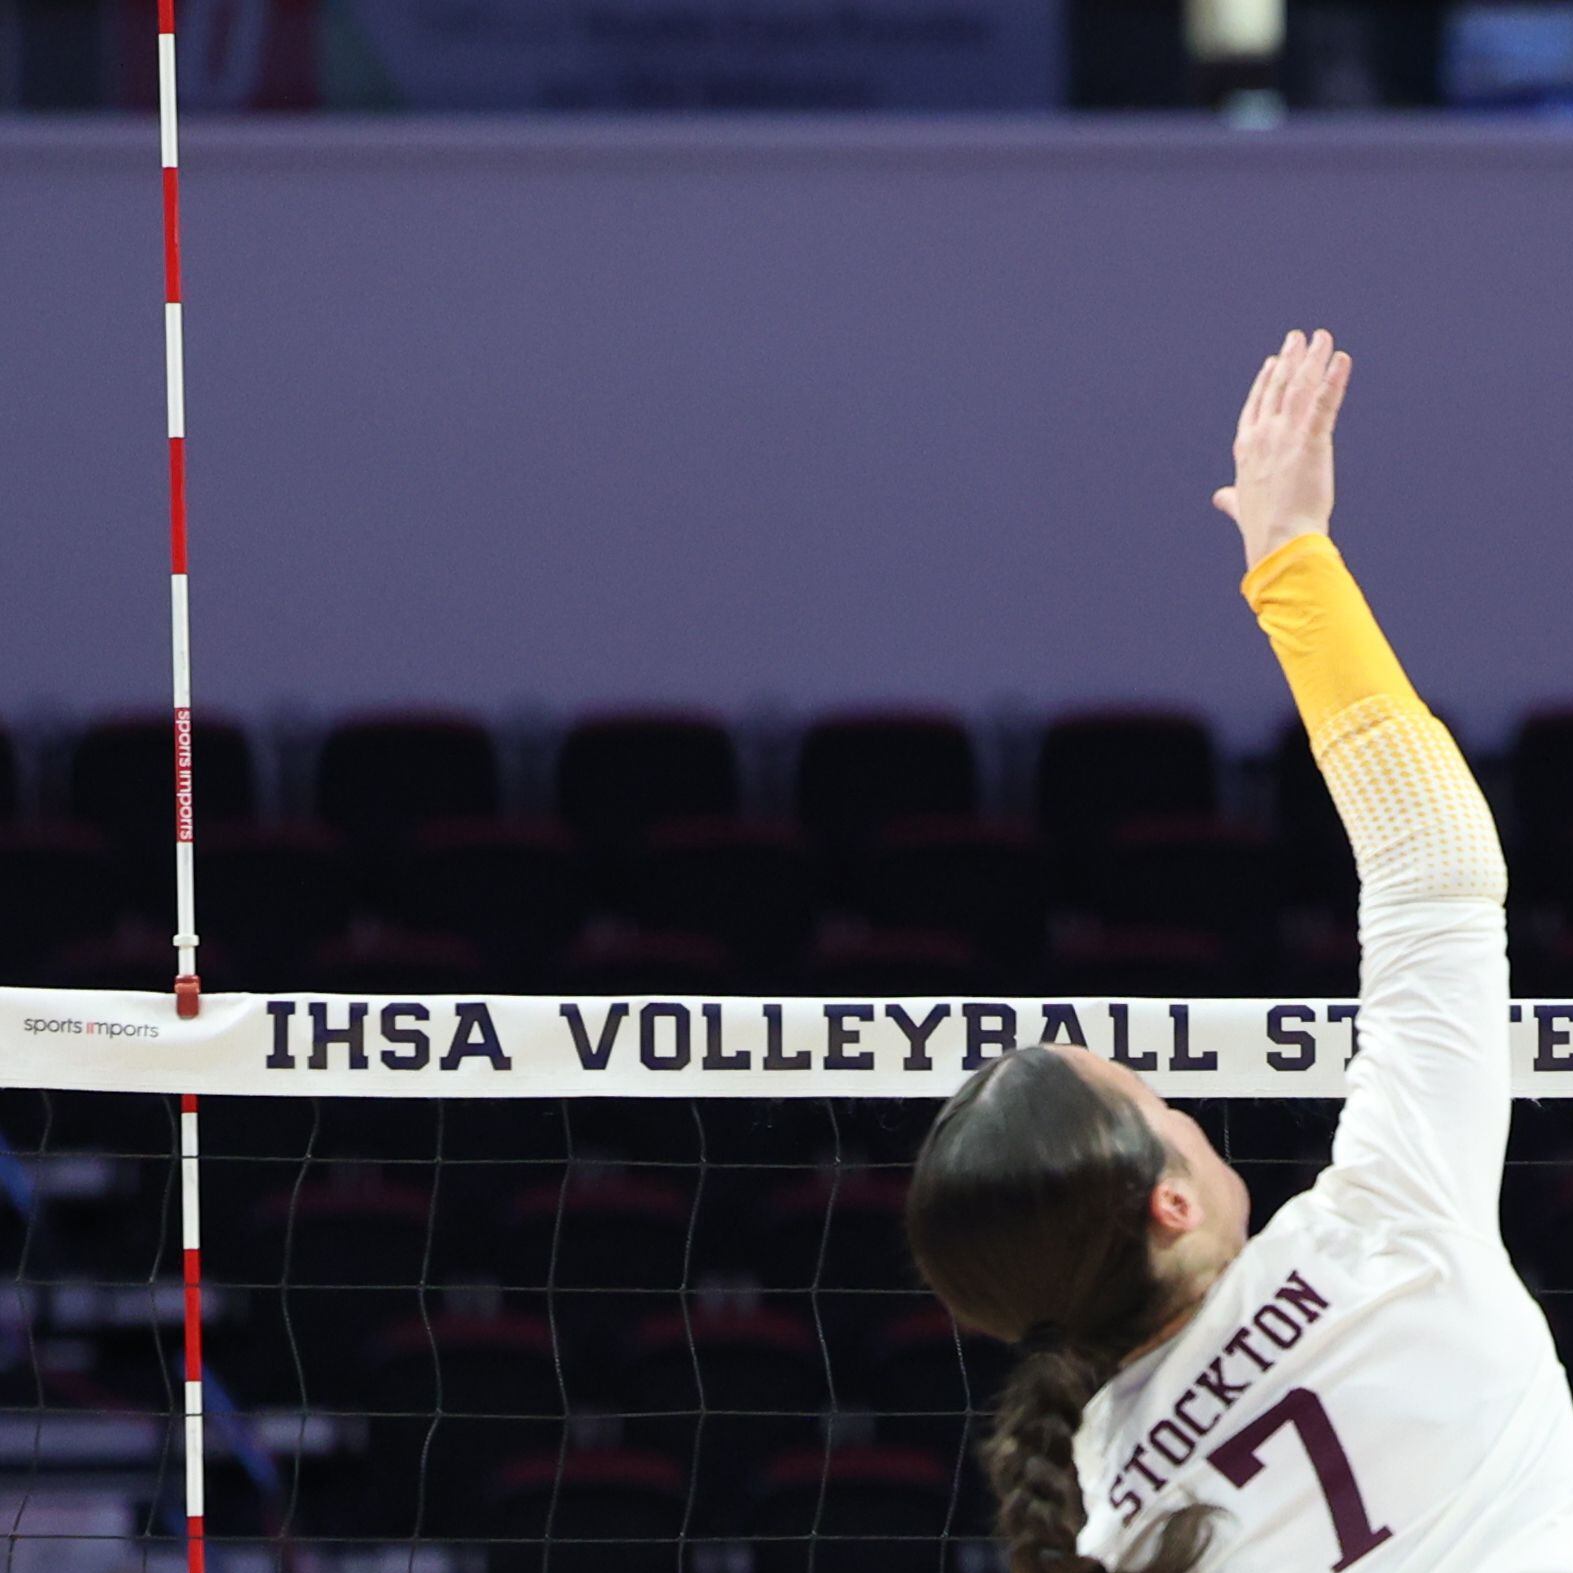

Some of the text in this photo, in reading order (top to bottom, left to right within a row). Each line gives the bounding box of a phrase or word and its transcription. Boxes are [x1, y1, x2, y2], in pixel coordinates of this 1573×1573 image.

[175, 710, 192, 768] sports
[23, 1015, 83, 1036] sports
[267, 1001, 512, 1071] IHSA
[560, 1003, 1218, 1072] VOLLEYBALL
[1108, 1269, 1330, 1527] STOCKTON
